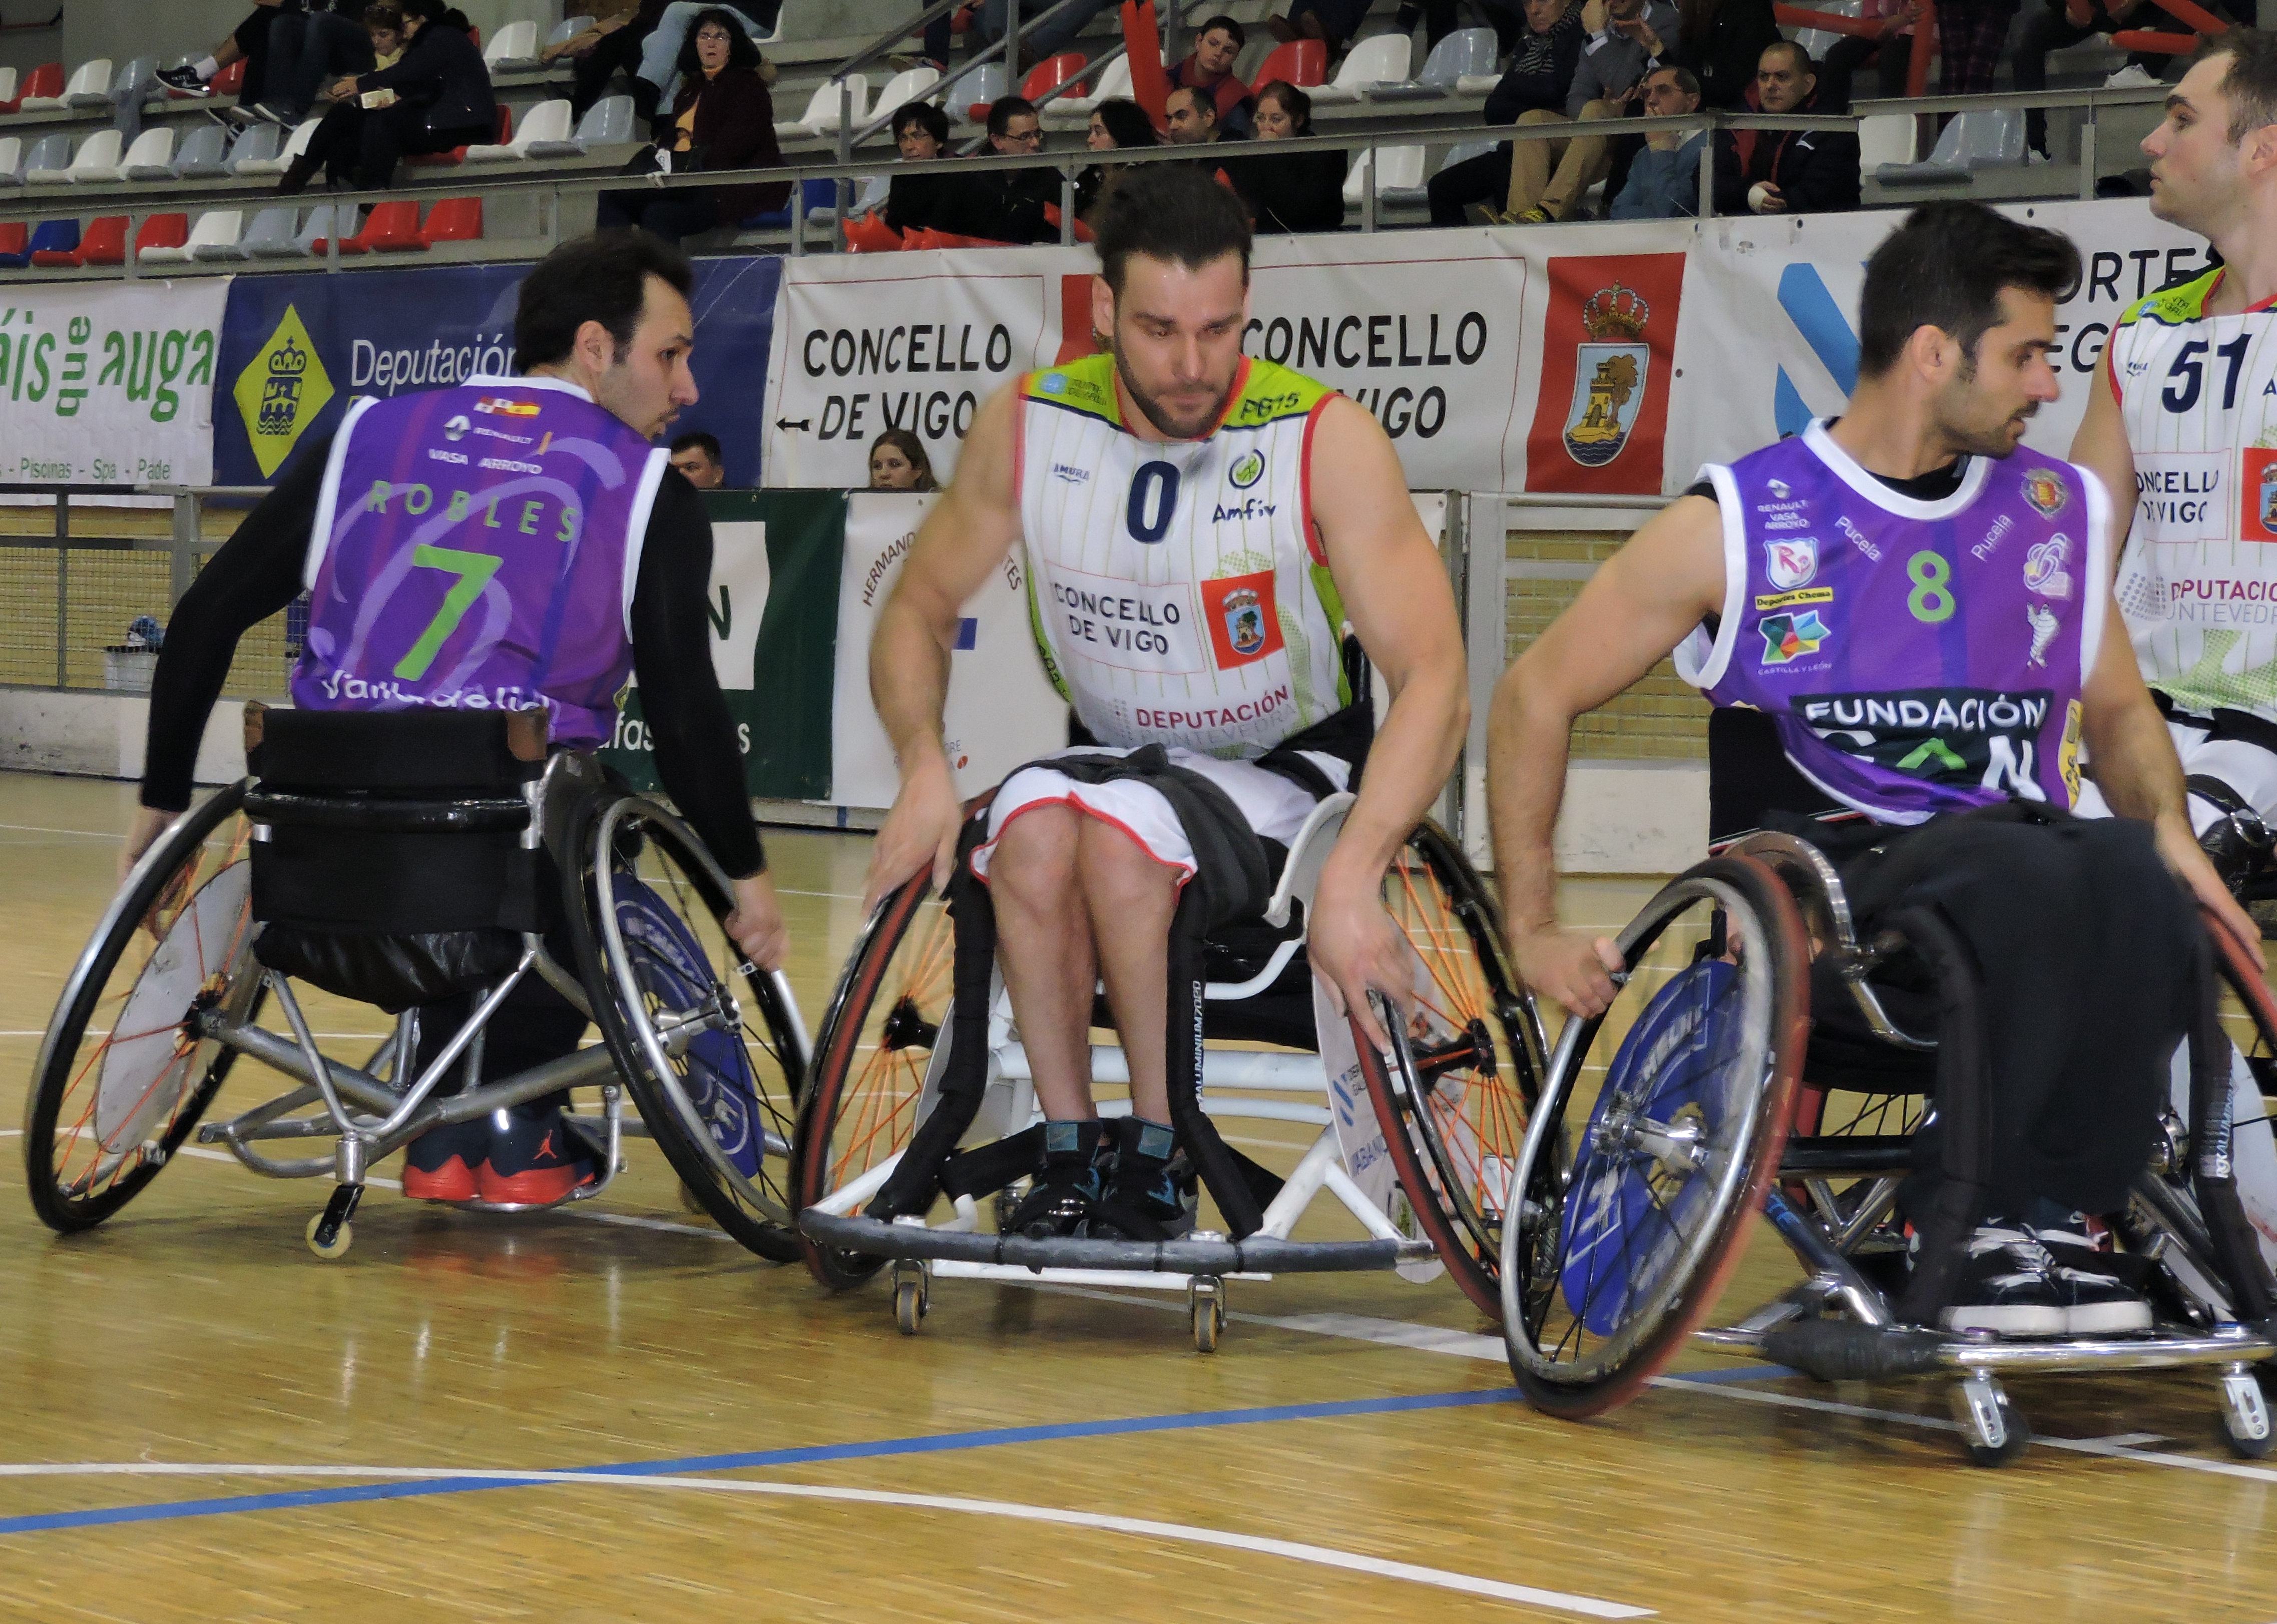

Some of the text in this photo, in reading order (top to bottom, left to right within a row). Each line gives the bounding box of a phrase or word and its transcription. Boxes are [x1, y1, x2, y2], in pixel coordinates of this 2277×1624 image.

[803, 324, 1012, 377] CONCELLO
[1240, 311, 1487, 369] CONCELLO
[56, 316, 92, 416] que
[98, 329, 215, 422] auga
[2162, 334, 2253, 414] 51
[818, 390, 978, 440] DE VIGO
[93, 458, 116, 481] Spa
[428, 449, 543, 474] VASA ARROYO
[367, 480, 579, 542] ROBLES
[1127, 461, 1180, 545] 0
[1212, 499, 1276, 524] Amfiv
[1757, 500, 1808, 513] RENAULT
[1765, 518, 1811, 530] ARROYO
[1770, 512, 1800, 522] VASA
[1835, 515, 1884, 563] Pucela
[1971, 514, 2015, 562] Pucela
[1054, 582, 1180, 626] CONCELLO
[1907, 550, 1956, 623] 8
[393, 544, 505, 681] 7
[1068, 614, 1169, 655] DE VIGO
[1136, 685, 1289, 729] DEPUTACIÓN
[1805, 694, 2047, 732] FUNDACIÓN
